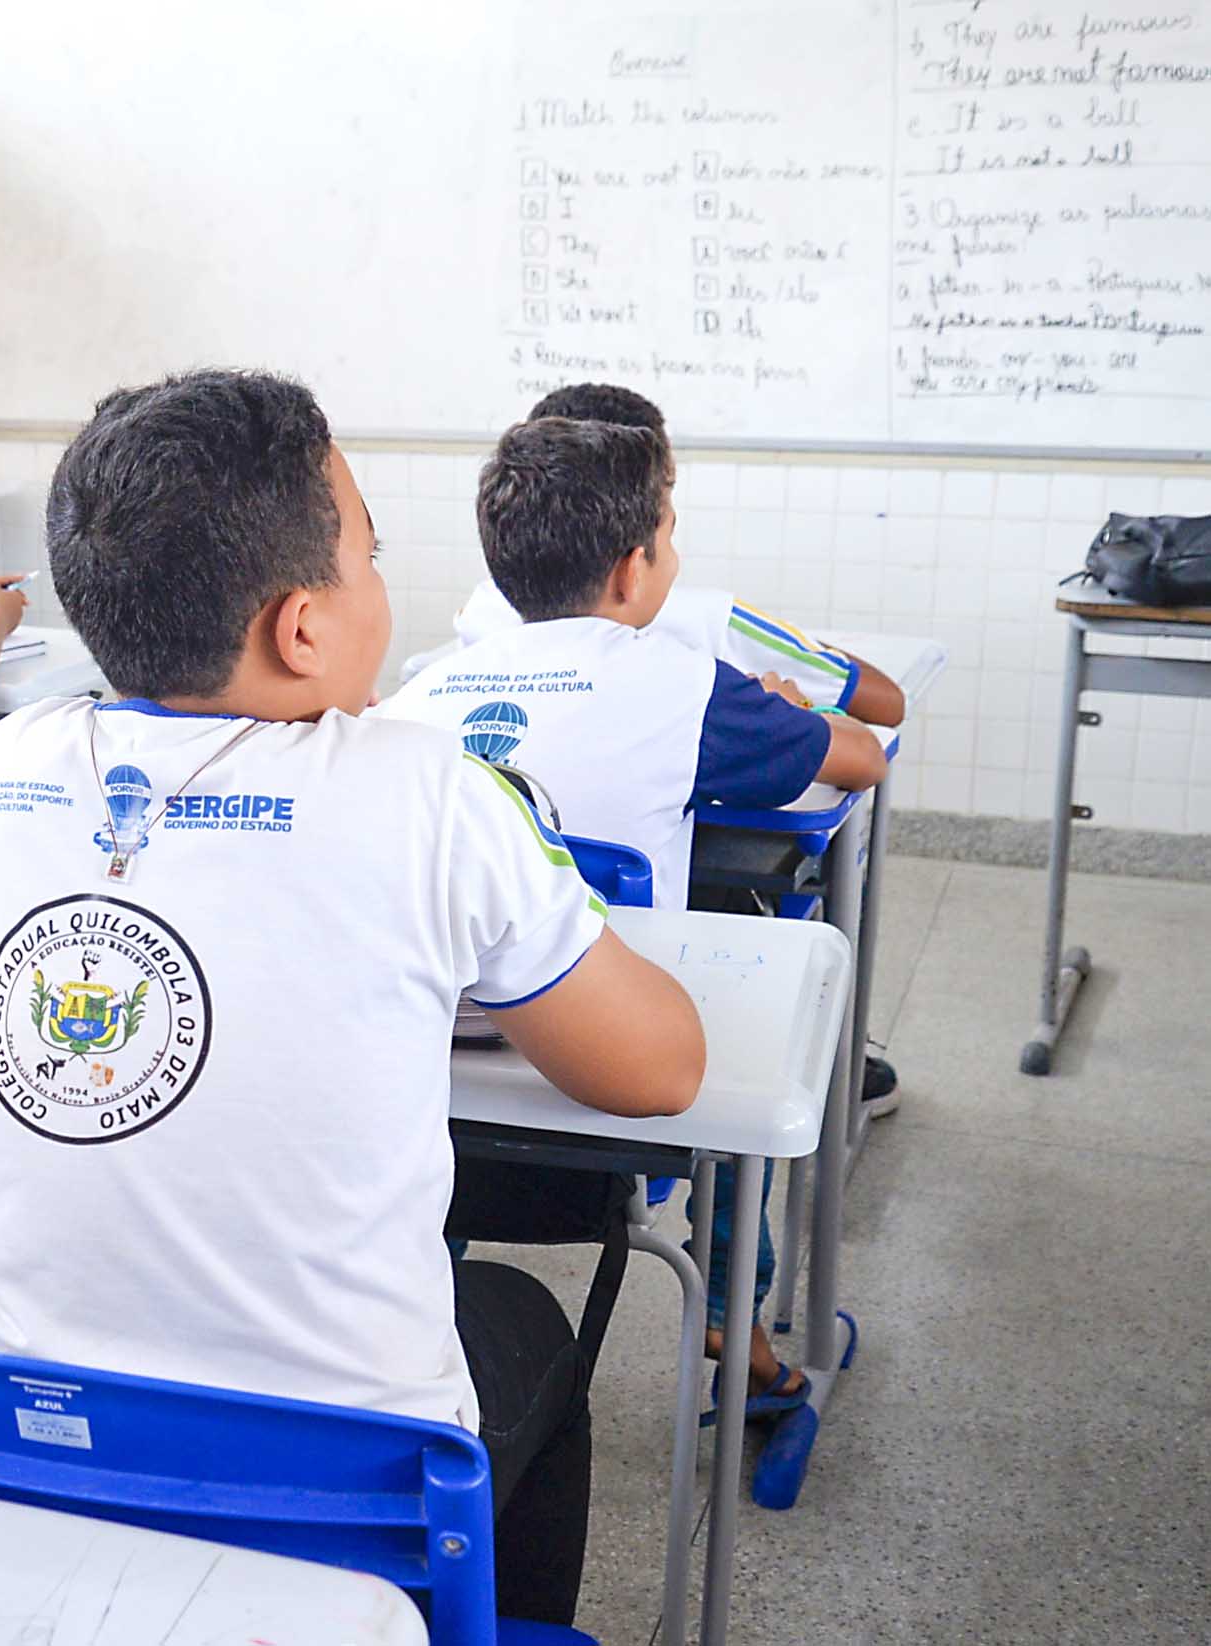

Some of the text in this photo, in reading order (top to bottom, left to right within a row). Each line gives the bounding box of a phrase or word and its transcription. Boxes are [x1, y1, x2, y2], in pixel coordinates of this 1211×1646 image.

[944, 21, 997, 59] They
[1015, 18, 1054, 41] are
[922, 56, 991, 90] They
[1005, 63, 1046, 86] are
[1053, 47, 1101, 83] not
[536, 98, 614, 128] Match
[631, 99, 668, 126] the
[945, 100, 981, 133] It
[997, 116, 1028, 132] is
[1046, 112, 1064, 129] a
[1083, 97, 1143, 128] ball
[937, 144, 965, 175] It
[980, 151, 1005, 170] is
[1015, 144, 1052, 167] not
[445, 682, 506, 694] EDUCAÇÃO
[508, 684, 514, 693] E
[517, 683, 534, 693] DA
[538, 681, 594, 692] CULTURA
[446, 669, 577, 683] SECRETARIA DE ESTADO
[471, 722, 518, 735] PORVIR
[29, 782, 65, 794] ESTADO
[30, 793, 75, 807] ESPORTE
[165, 795, 295, 821] SERGIPE
[164, 819, 293, 833] GOVERNO DO ESTADO
[30, 935, 158, 982] A EDUCAÇÃO RESISTE!
[69, 911, 194, 1006] QUILOMBOLA
[176, 1016, 196, 1047] 03
[160, 1054, 187, 1088] DE
[62, 1086, 89, 1097] 1994
[99, 1087, 162, 1129] MAIO
[34, 1399, 66, 1412] AZUL
